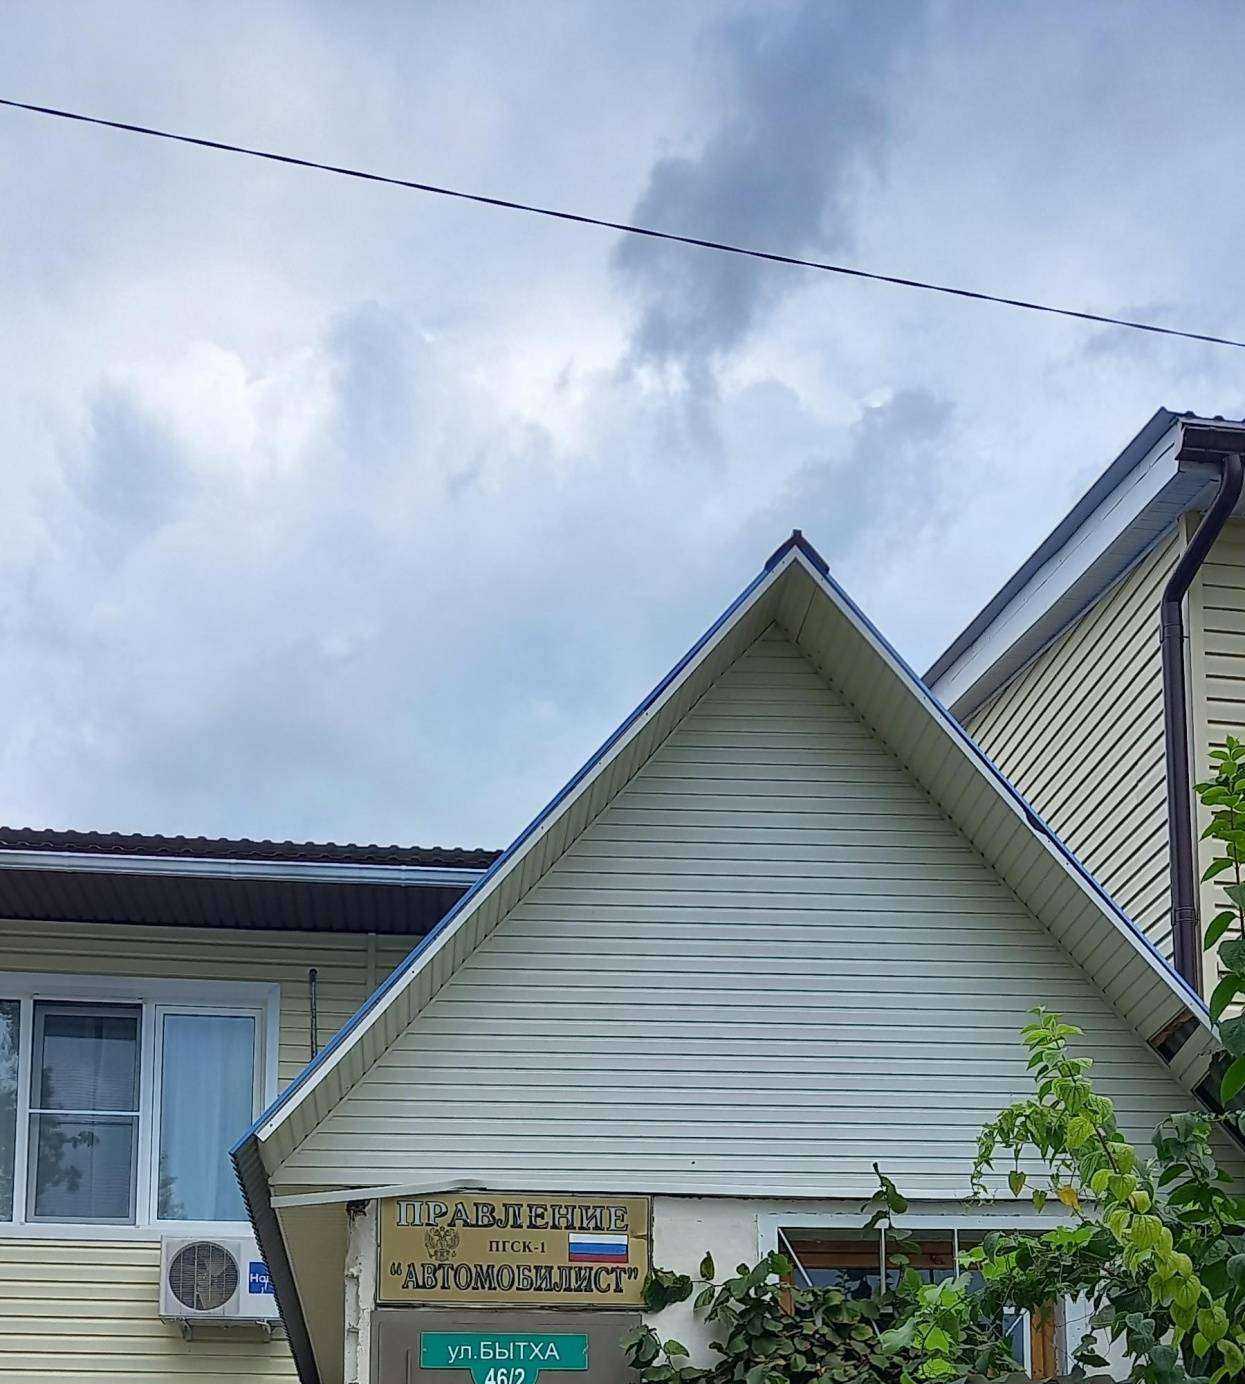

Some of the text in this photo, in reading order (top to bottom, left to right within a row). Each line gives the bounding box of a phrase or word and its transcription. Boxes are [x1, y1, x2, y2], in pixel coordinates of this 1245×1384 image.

[396, 1199, 629, 1232] ПРАВЛЕНИЕ
[488, 1240, 546, 1254] ПГСК-1
[447, 1341, 561, 1364] ул.БЫТХА
